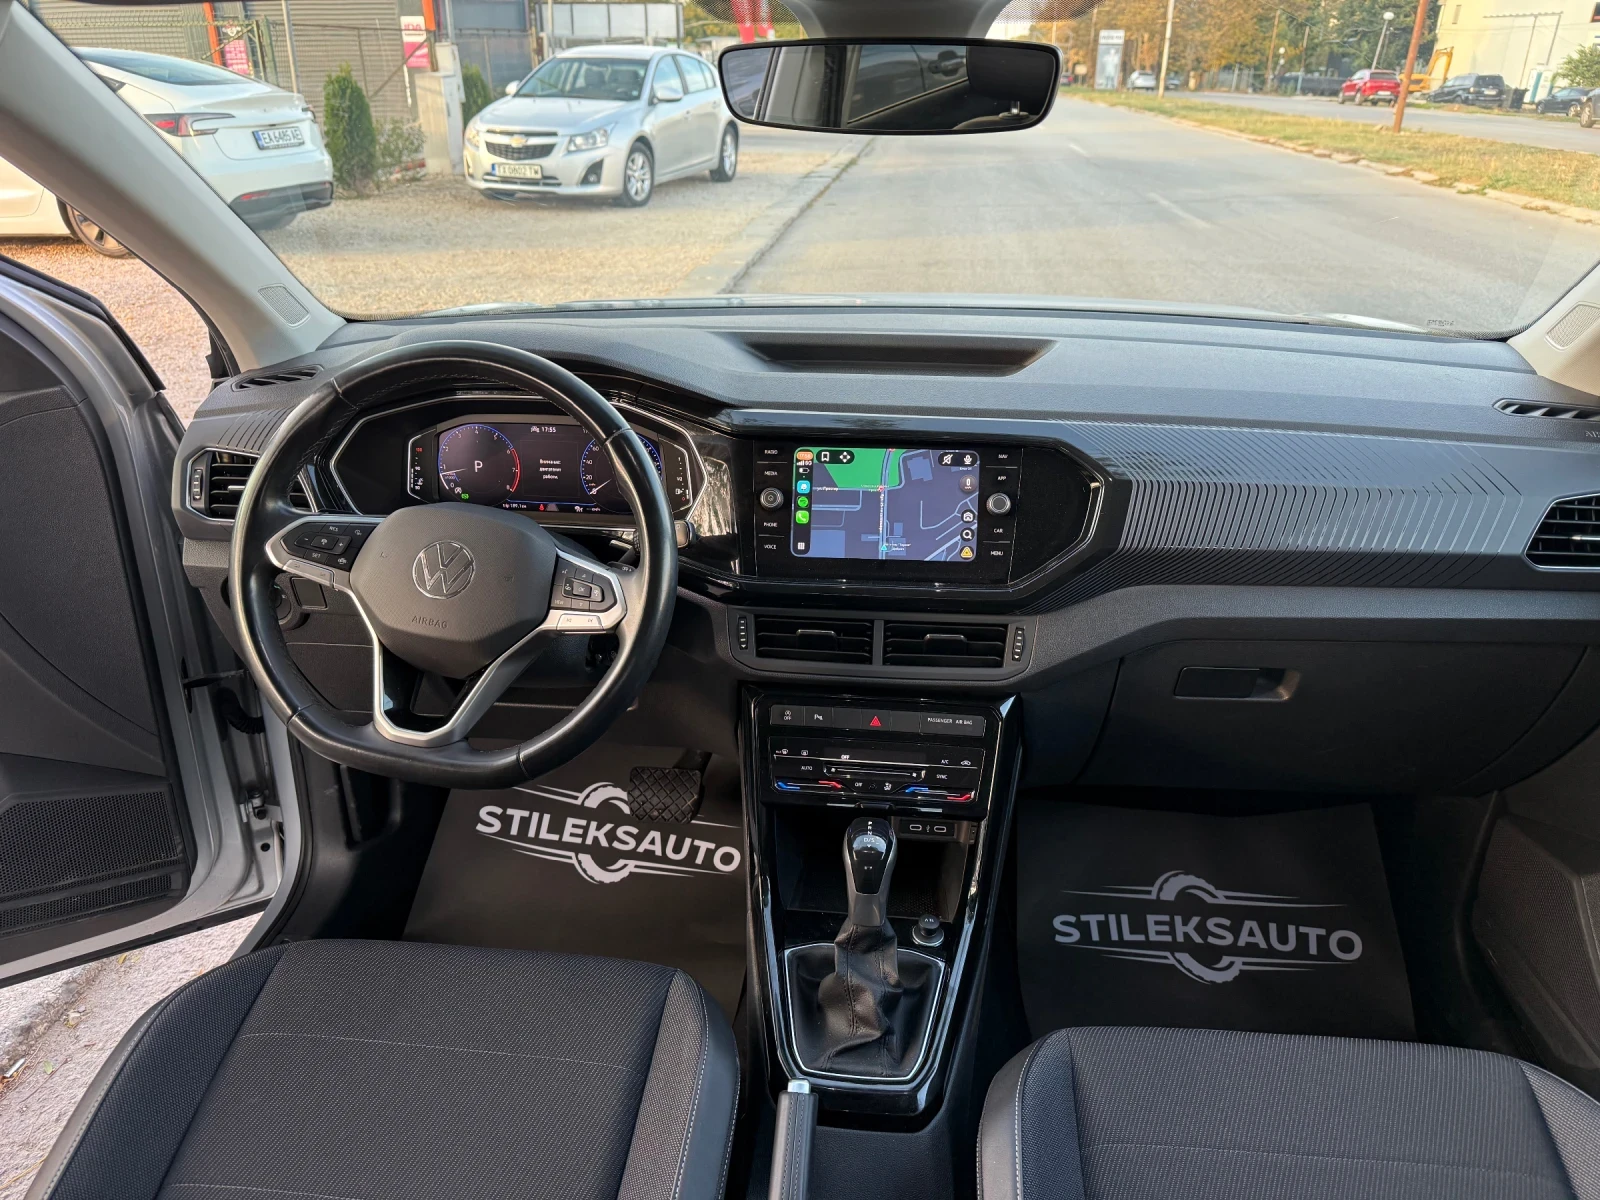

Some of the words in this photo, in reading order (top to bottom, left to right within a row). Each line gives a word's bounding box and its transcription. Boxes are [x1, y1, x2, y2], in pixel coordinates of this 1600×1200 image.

[474, 460, 483, 473] P
[411, 615, 448, 629] AIRBAG
[475, 805, 741, 872] STILEKSAUTO
[1052, 914, 1363, 961] STILEKSAUTO
